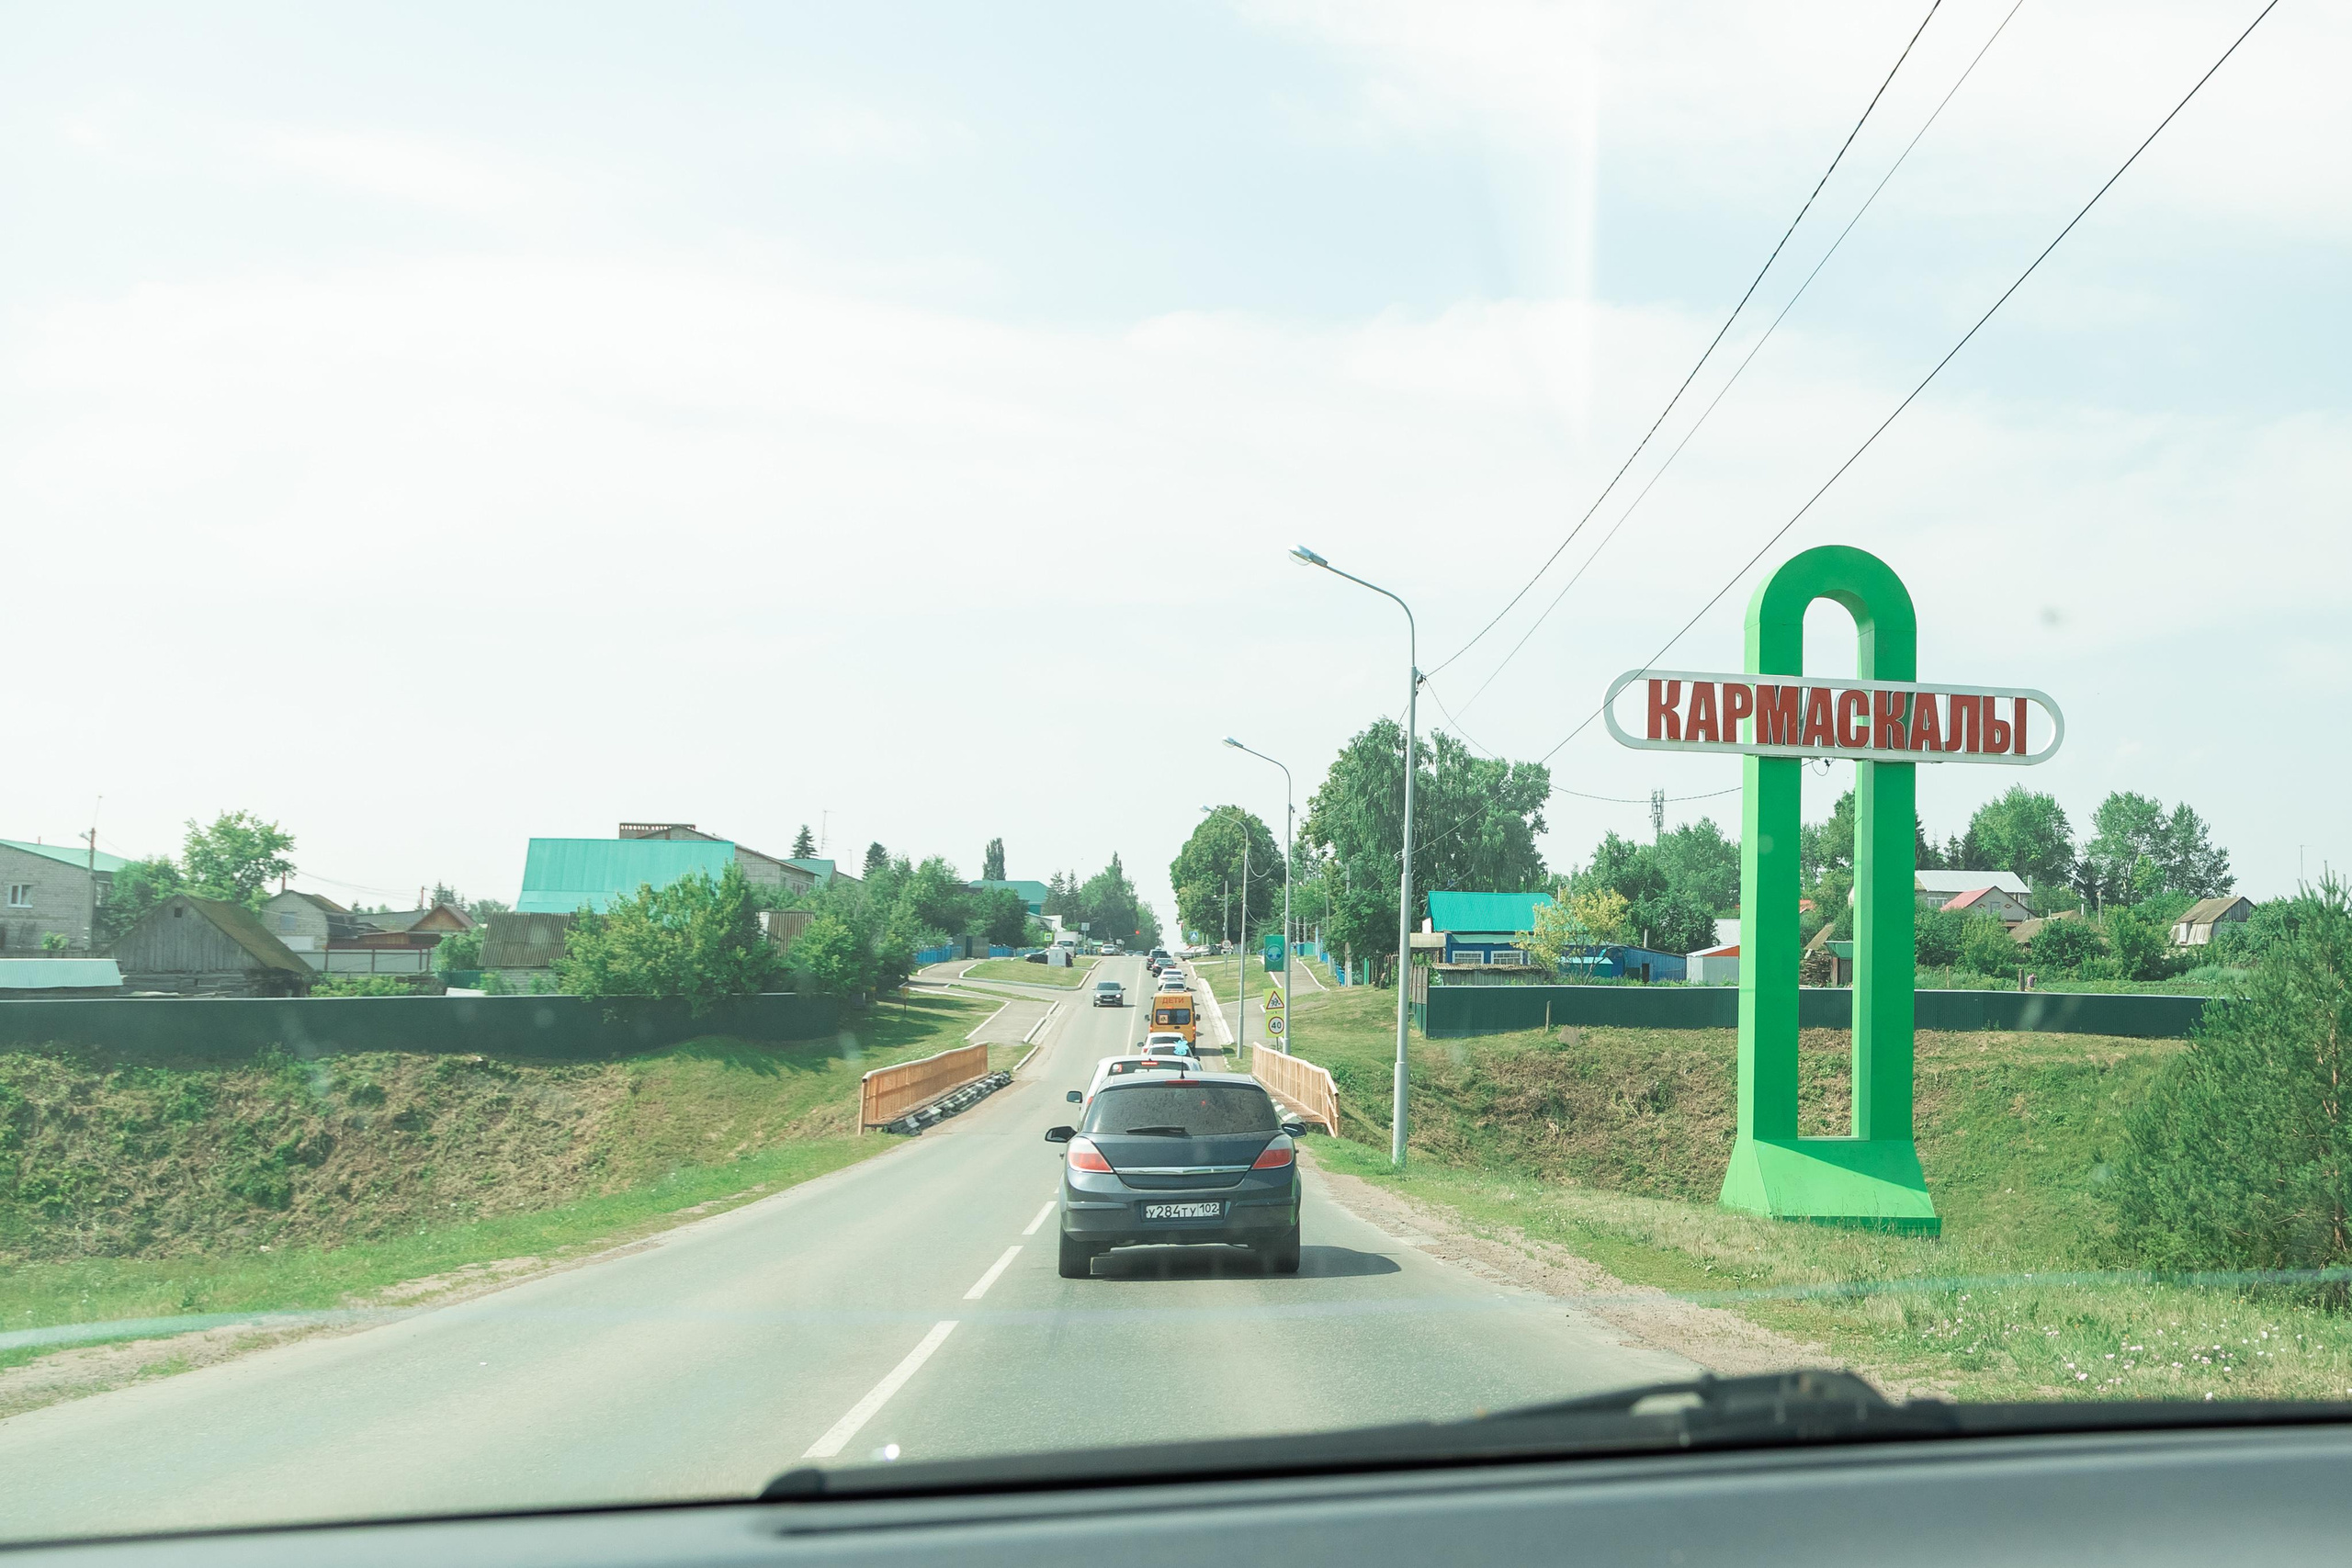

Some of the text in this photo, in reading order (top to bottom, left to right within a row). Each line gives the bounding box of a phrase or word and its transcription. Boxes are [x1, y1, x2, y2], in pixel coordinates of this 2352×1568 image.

[1646, 679, 2029, 755] КАРМАСКАЛЫ
[1162, 997, 1184, 1005] ДЕТИ
[1271, 1021, 1282, 1030] 40
[1199, 1203, 1217, 1213] 102
